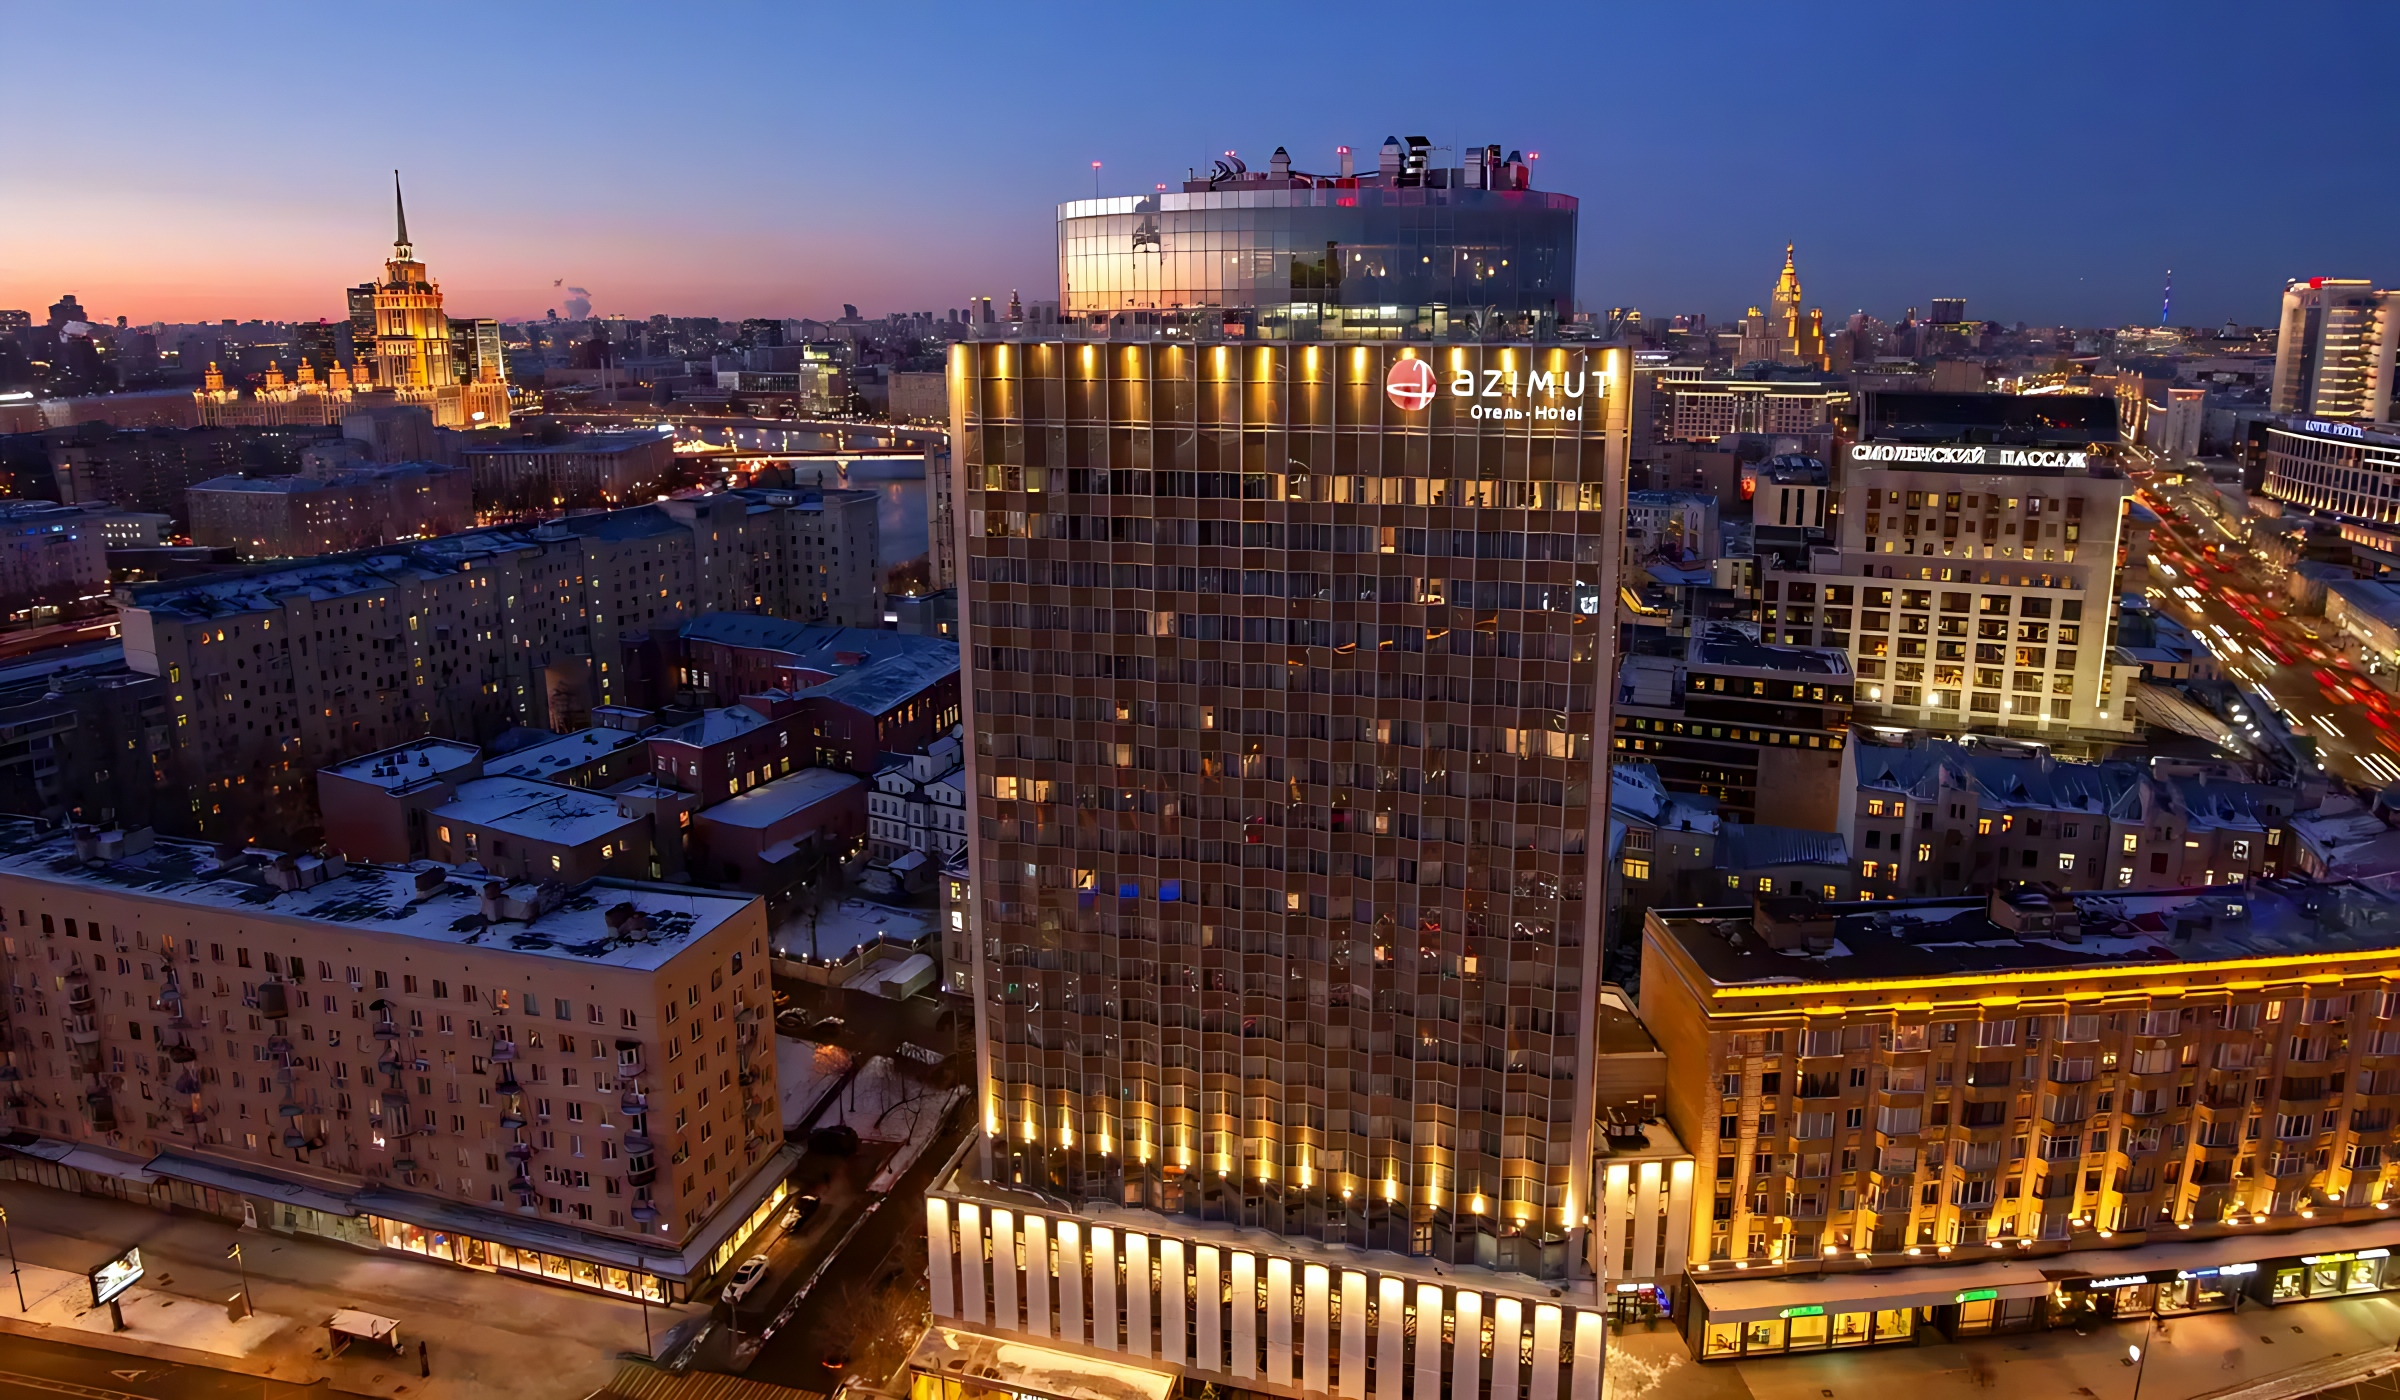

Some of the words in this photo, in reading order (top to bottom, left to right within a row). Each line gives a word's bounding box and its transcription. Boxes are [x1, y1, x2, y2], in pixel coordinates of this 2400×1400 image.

[1470, 404, 1523, 420] Отель
[1535, 405, 1583, 421] Hotel
[2000, 450, 2087, 469] ПАССАЖ
